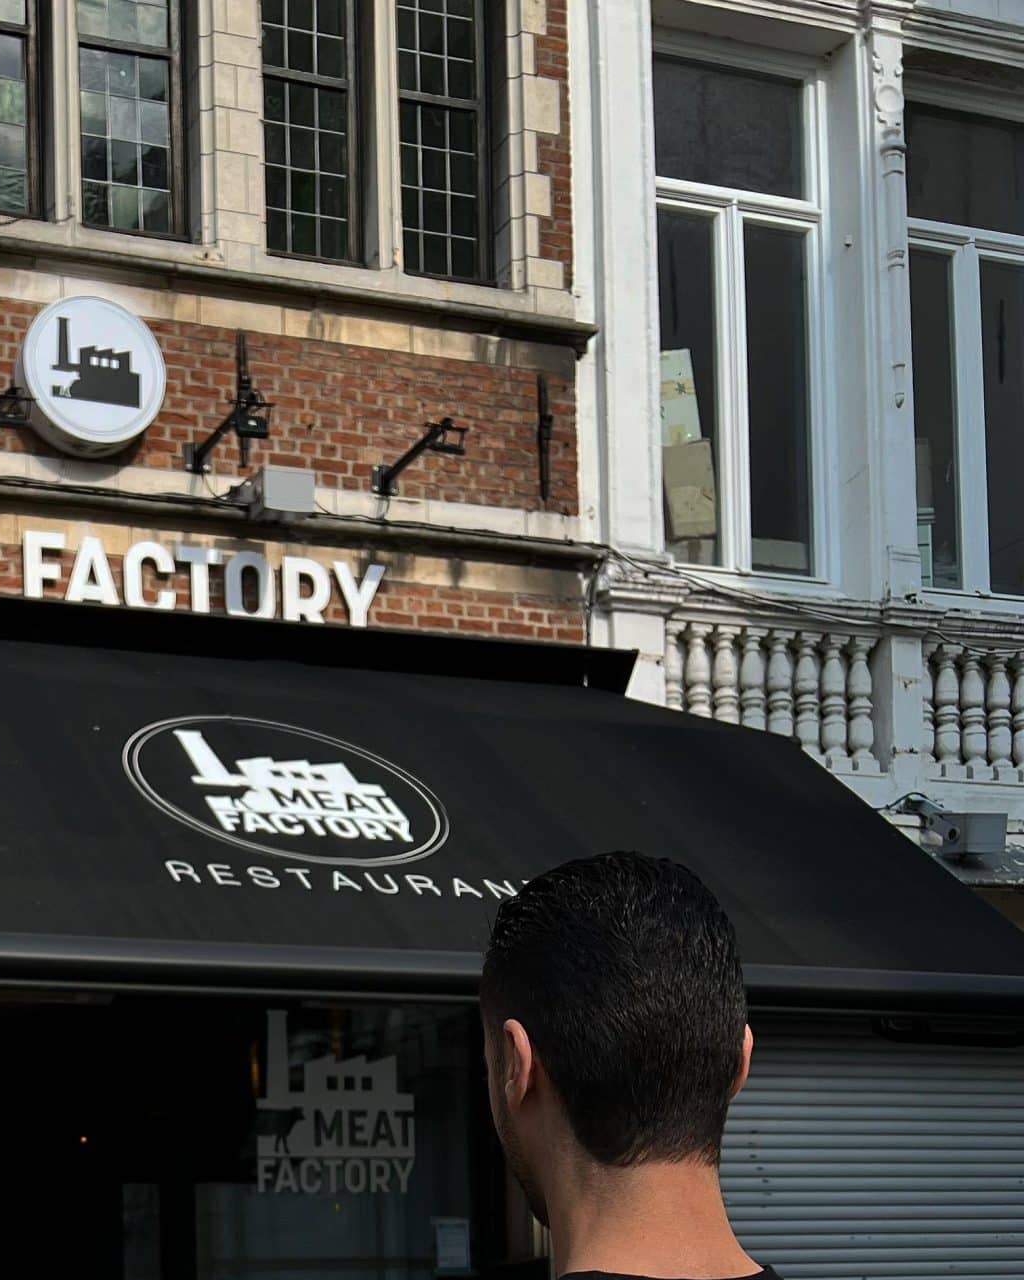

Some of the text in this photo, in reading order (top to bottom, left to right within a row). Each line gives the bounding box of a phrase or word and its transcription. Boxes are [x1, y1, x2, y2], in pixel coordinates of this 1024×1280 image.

[22, 529, 386, 629] FACTORY
[267, 786, 392, 815] MEAT
[214, 809, 414, 843] FACTORY
[164, 859, 532, 900] RESTAURAN
[313, 1108, 414, 1149] MEAT
[256, 1158, 415, 1194] FACTORY
